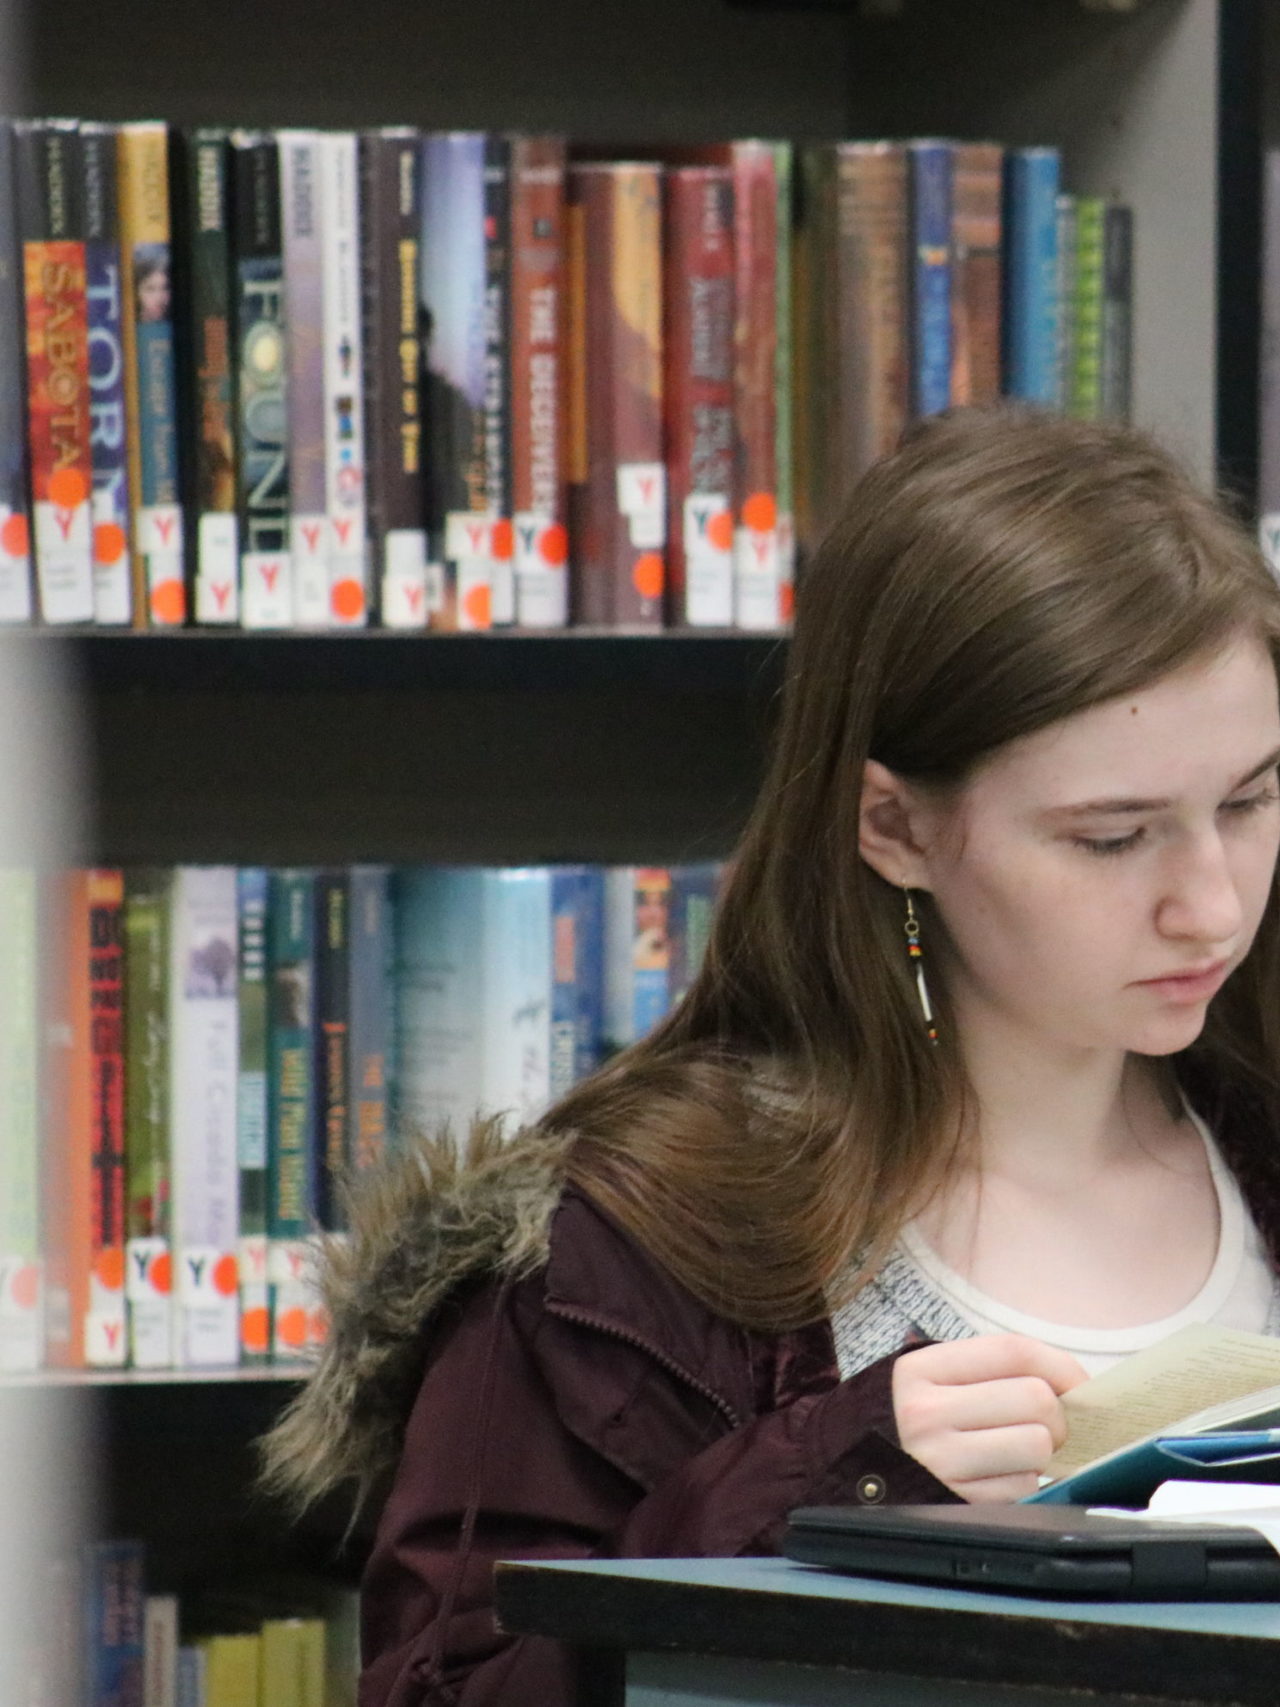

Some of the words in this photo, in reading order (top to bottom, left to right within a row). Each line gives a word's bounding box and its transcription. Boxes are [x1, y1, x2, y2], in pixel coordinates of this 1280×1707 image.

[530, 287, 557, 345] THE
[42, 260, 82, 471] SABOTA
[54, 508, 76, 540] Y
[155, 515, 173, 544] Y
[333, 518, 351, 544] Y
[519, 519, 536, 552] Y
[302, 525, 321, 552] Y
[260, 565, 279, 592] Y
[210, 584, 231, 612] Y
[404, 586, 424, 612] Y
[133, 1253, 151, 1282] Y
[188, 1259, 205, 1286] Y
[104, 1325, 119, 1350] Y
